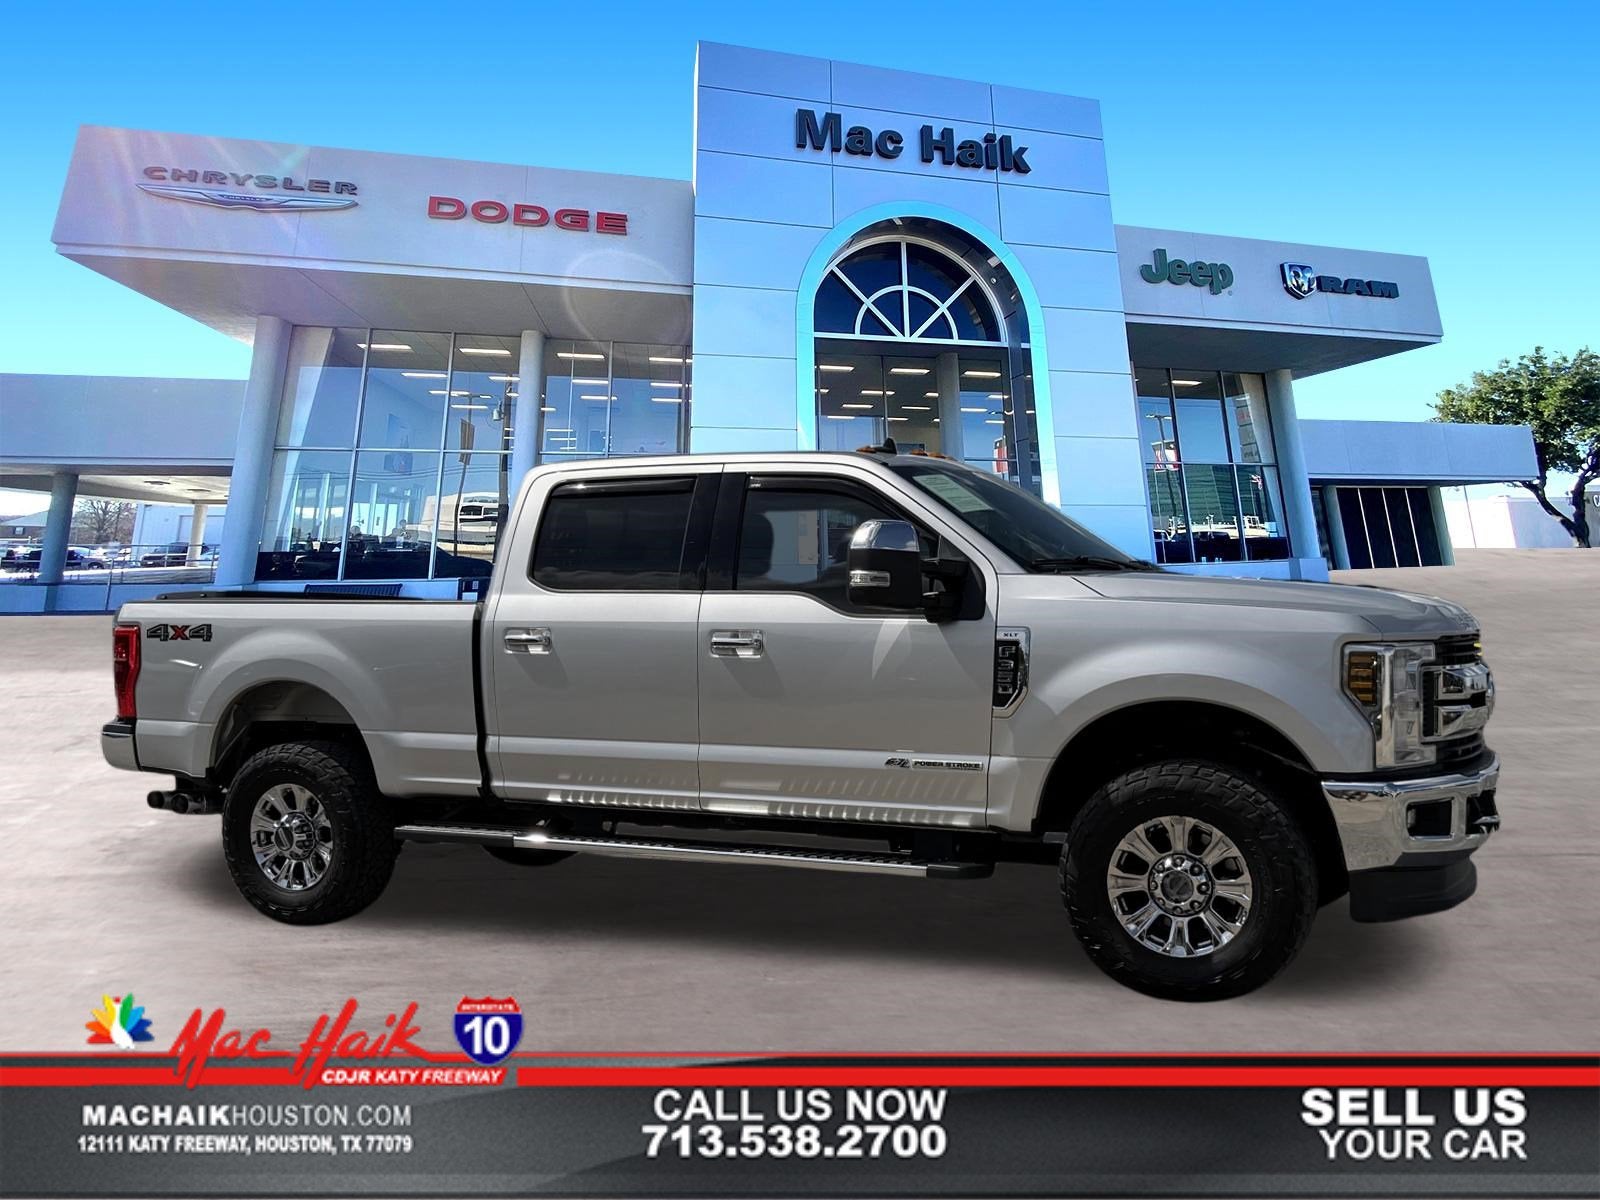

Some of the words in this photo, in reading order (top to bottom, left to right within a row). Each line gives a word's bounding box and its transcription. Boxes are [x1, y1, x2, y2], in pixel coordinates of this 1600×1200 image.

[796, 108, 904, 160] Mac
[919, 124, 1032, 174] Haik
[143, 166, 359, 196] CHRYSLER
[428, 196, 628, 236] DODGE
[1140, 248, 1234, 295] Jeep
[1316, 275, 1399, 299] RAM
